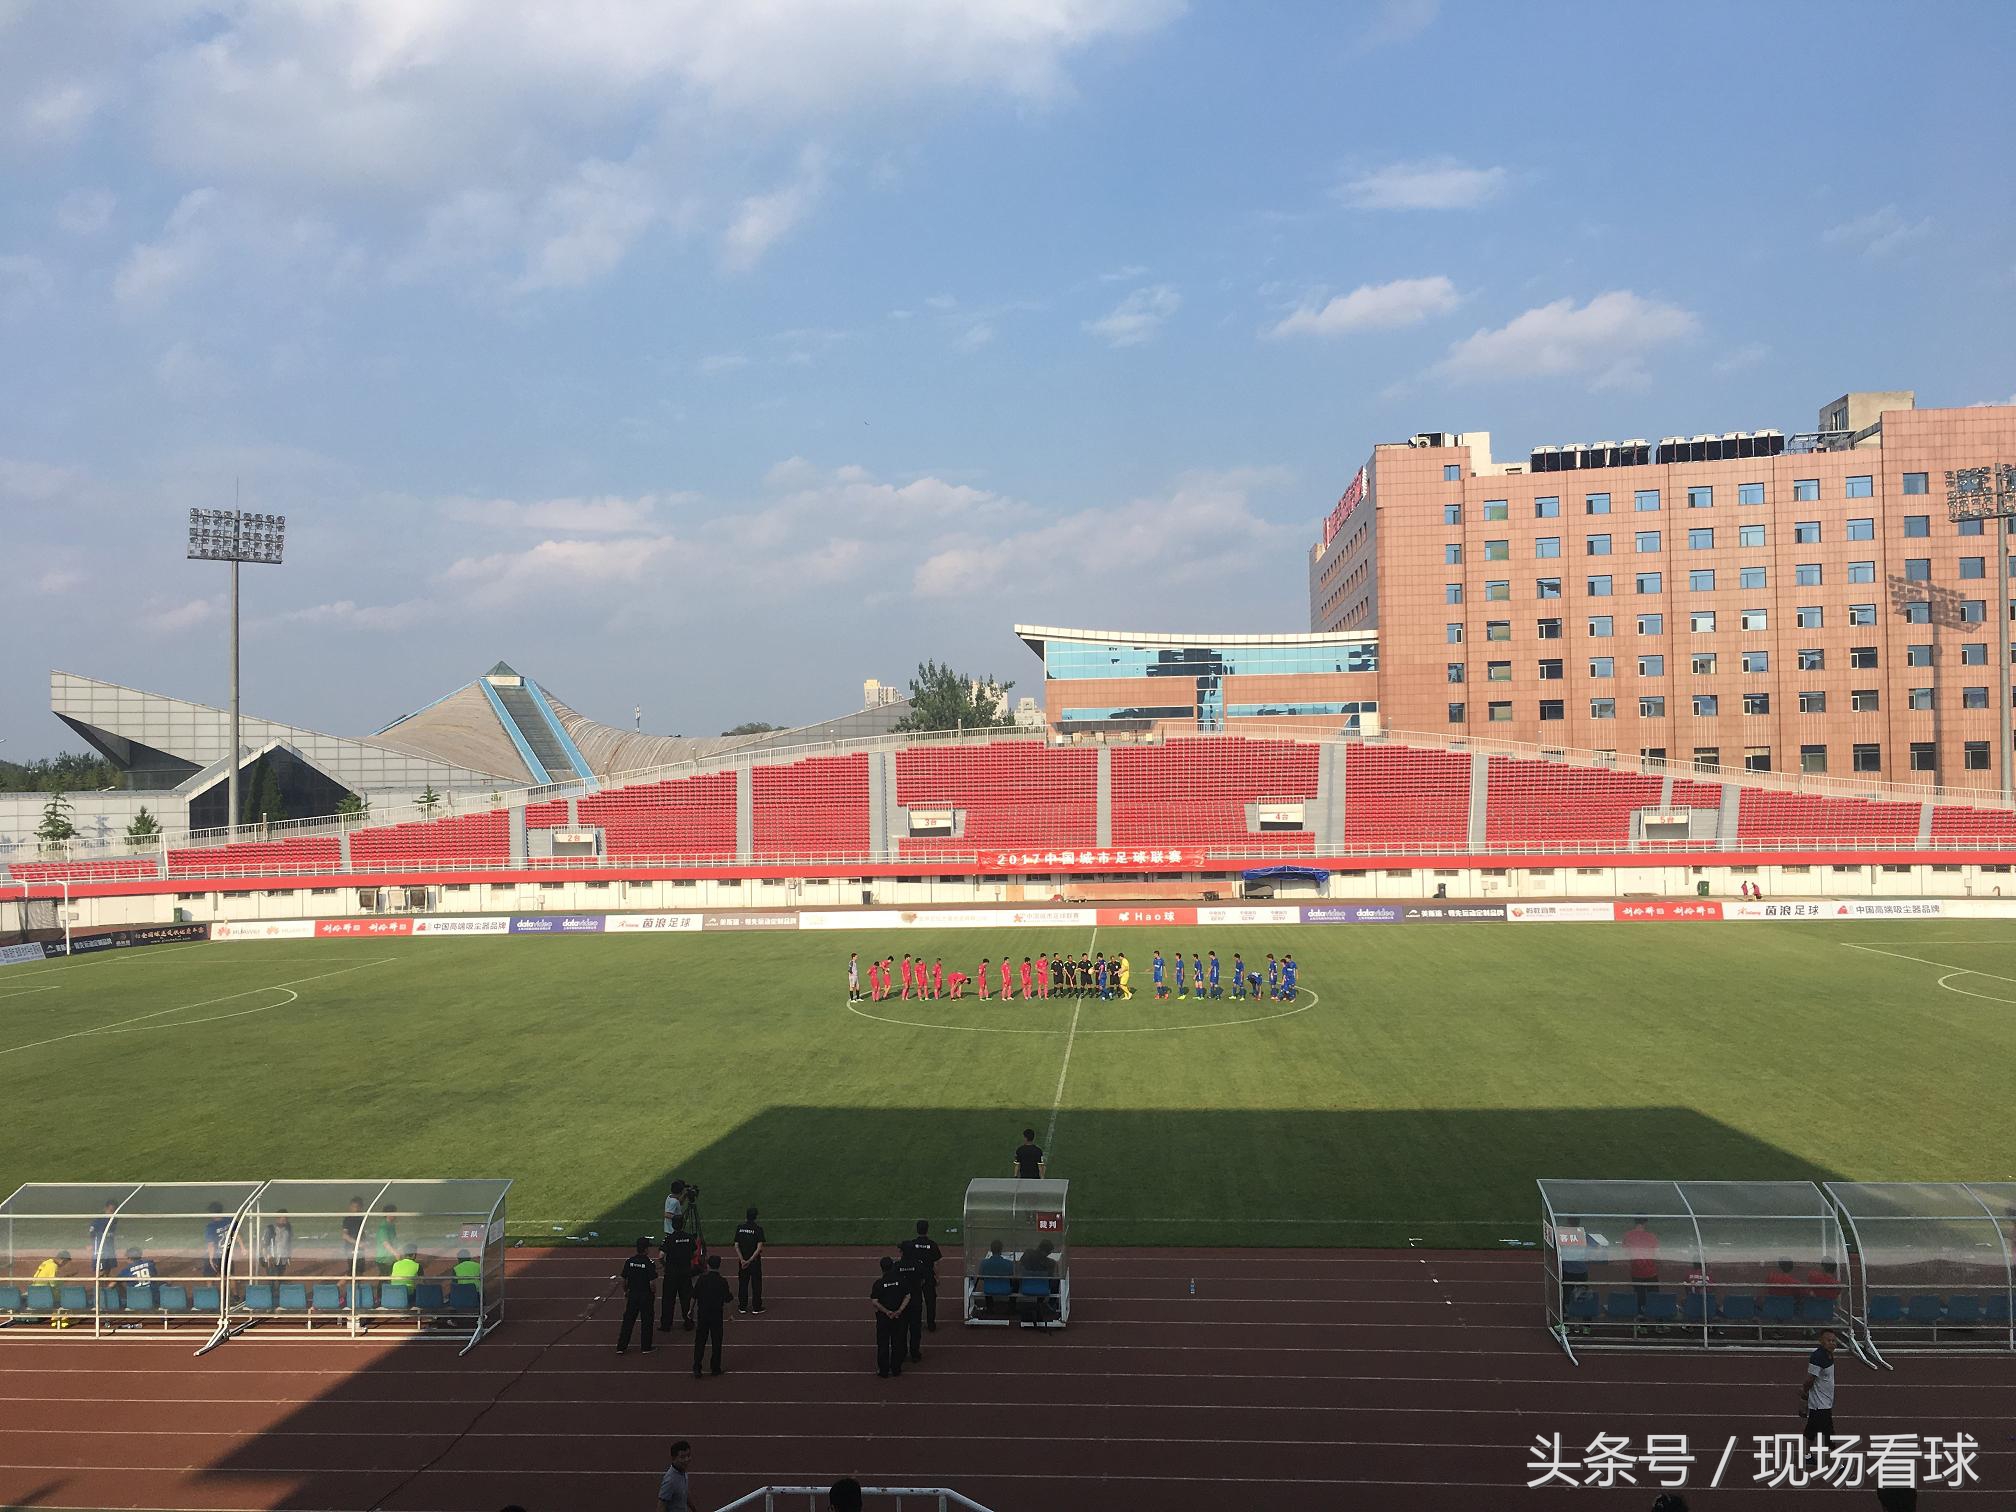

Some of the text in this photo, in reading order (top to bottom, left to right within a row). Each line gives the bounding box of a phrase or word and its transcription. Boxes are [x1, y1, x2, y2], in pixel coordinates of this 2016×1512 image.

[997, 850, 1183, 866] 2017中国城市足球联赛
[1308, 908, 1346, 917] datavideo
[1356, 908, 1395, 917] datavideo
[1765, 905, 1819, 916] 茵浪足球
[1855, 904, 1940, 915] 中国高端吸尘器品牌
[433, 921, 507, 931] 中国高端吸尘器品牌
[517, 918, 553, 928] datavideo
[562, 917, 599, 927] datavideo
[642, 917, 691, 928] 茵浪足球
